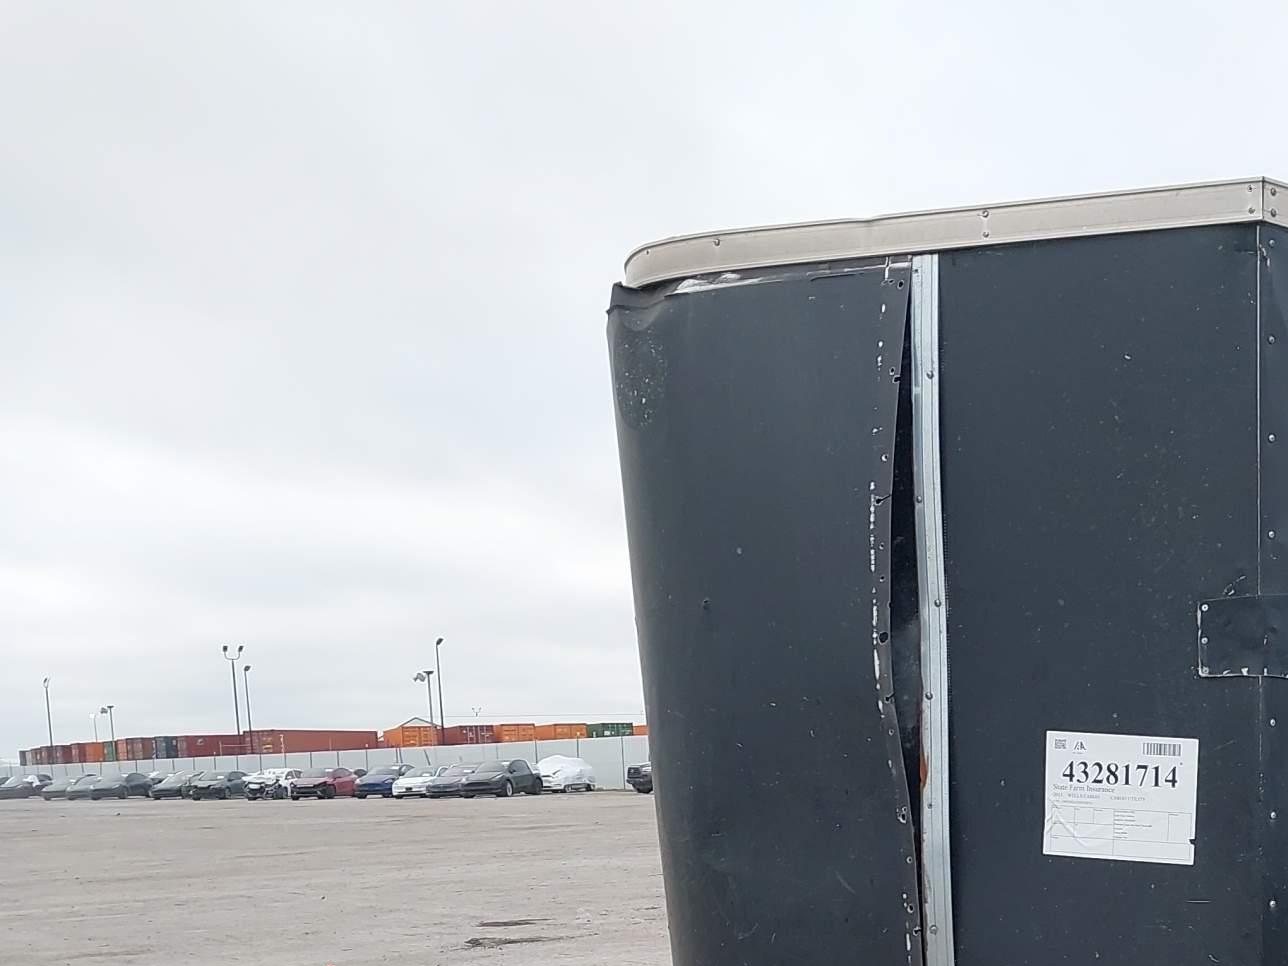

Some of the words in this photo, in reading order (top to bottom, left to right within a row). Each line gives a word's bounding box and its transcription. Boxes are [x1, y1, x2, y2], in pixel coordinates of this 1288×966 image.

[1062, 760, 1178, 788] 43281714
[1053, 783, 1068, 791] State
[1069, 784, 1085, 792] Farm
[1086, 785, 1115, 793] Insurance
